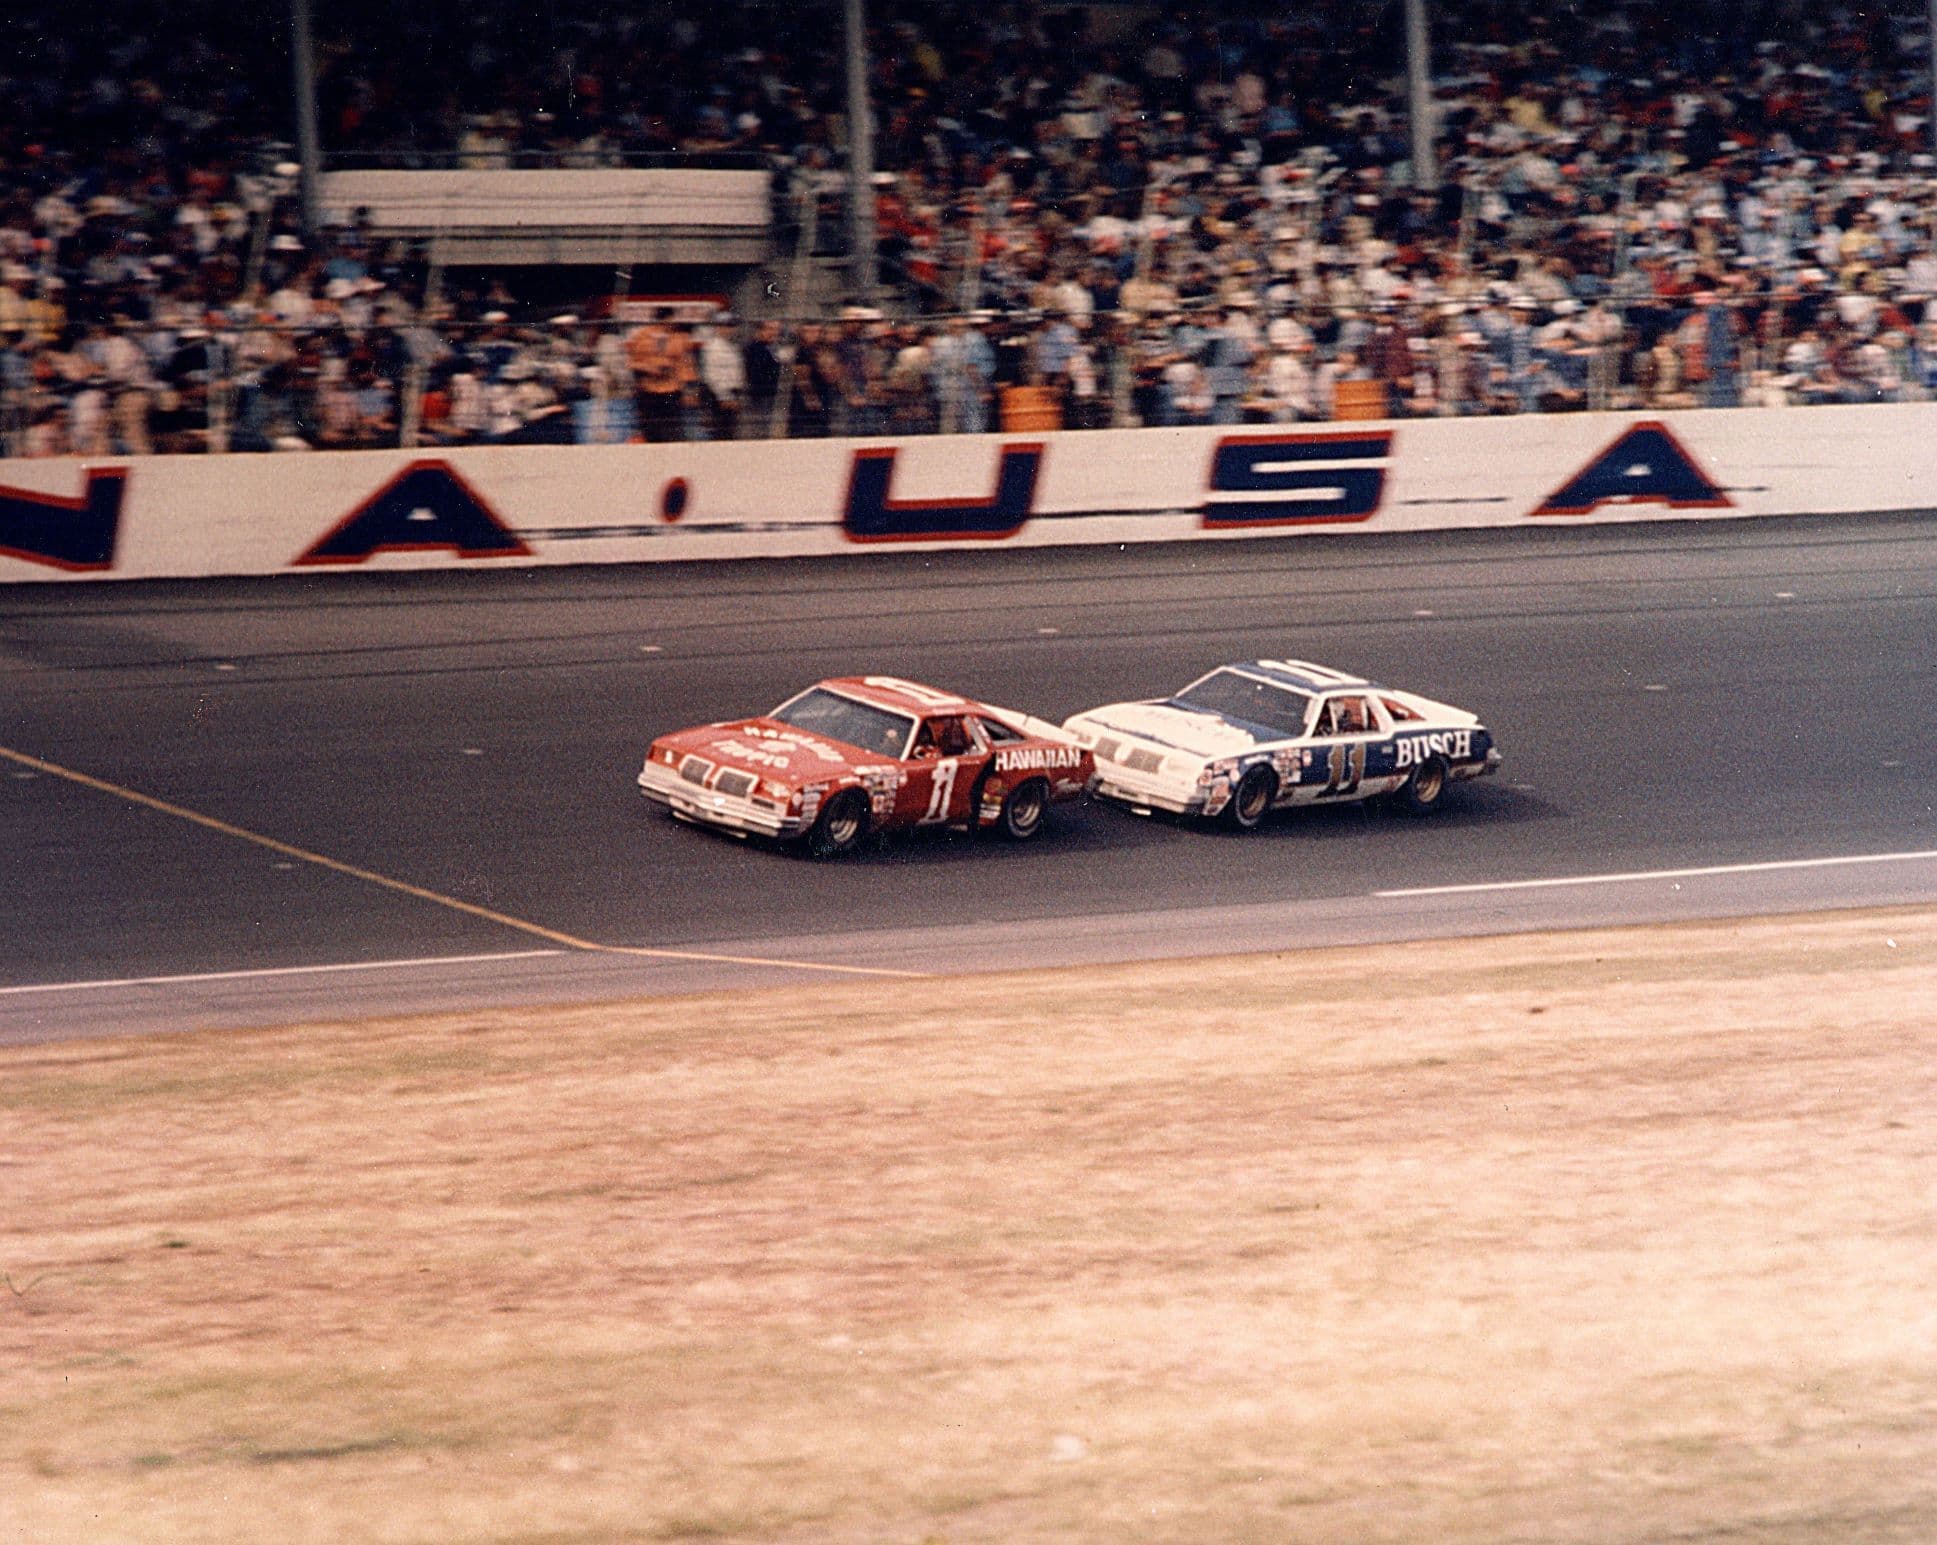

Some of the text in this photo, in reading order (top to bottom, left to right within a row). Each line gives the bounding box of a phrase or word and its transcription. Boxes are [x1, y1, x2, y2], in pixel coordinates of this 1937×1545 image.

[842, 420, 1734, 544] USA
[995, 748, 1081, 771] HAWAIIAN
[1315, 743, 1367, 798] 11
[1395, 730, 1472, 768] BUSCH
